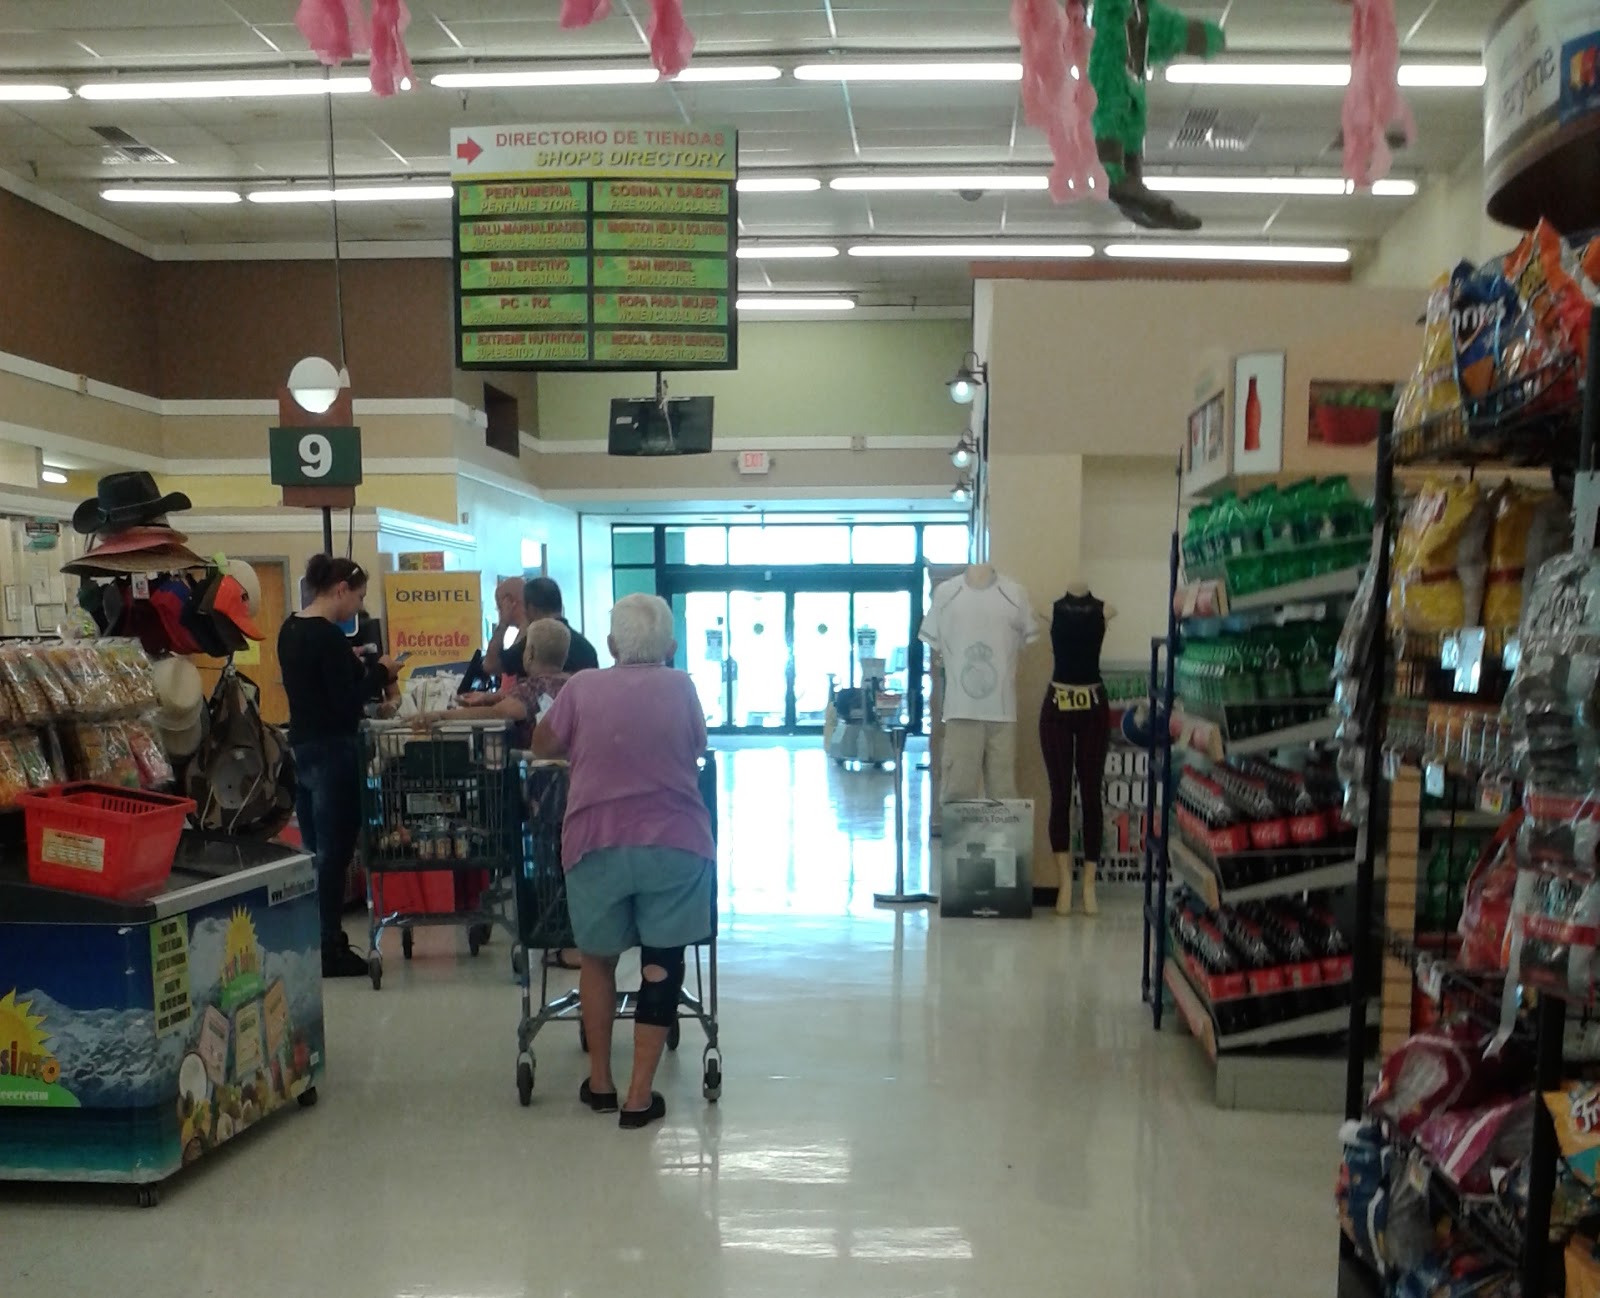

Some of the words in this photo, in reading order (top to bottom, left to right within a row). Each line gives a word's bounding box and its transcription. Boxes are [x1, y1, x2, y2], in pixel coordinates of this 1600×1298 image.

[495, 130, 608, 147] DIRECTORIO
[613, 130, 638, 145] DE
[644, 130, 725, 146] TIENDAS
[536, 150, 604, 167] SHOPS
[608, 150, 727, 168] DIRECTORY
[485, 184, 572, 199] PERFUMERIA
[664, 185, 673, 197] Y
[480, 200, 537, 213] PERFUME
[540, 199, 579, 211] STORE
[490, 260, 514, 272] MAS
[516, 259, 570, 272] EFECTIVO
[627, 259, 651, 272] SAN
[653, 259, 694, 272] MIGUEL
[500, 297, 520, 310] PC
[618, 295, 648, 307] ROPA
[650, 296, 679, 308] PARA
[682, 297, 719, 309] MUJER
[477, 333, 526, 346] EXTREME
[528, 332, 585, 345] NUTRITION
[611, 333, 648, 346] MEDICAL
[298, 433, 333, 478] 9
[744, 452, 764, 468] EXIT
[395, 588, 475, 602] ORBITEL
[396, 631, 471, 647] Acércate
